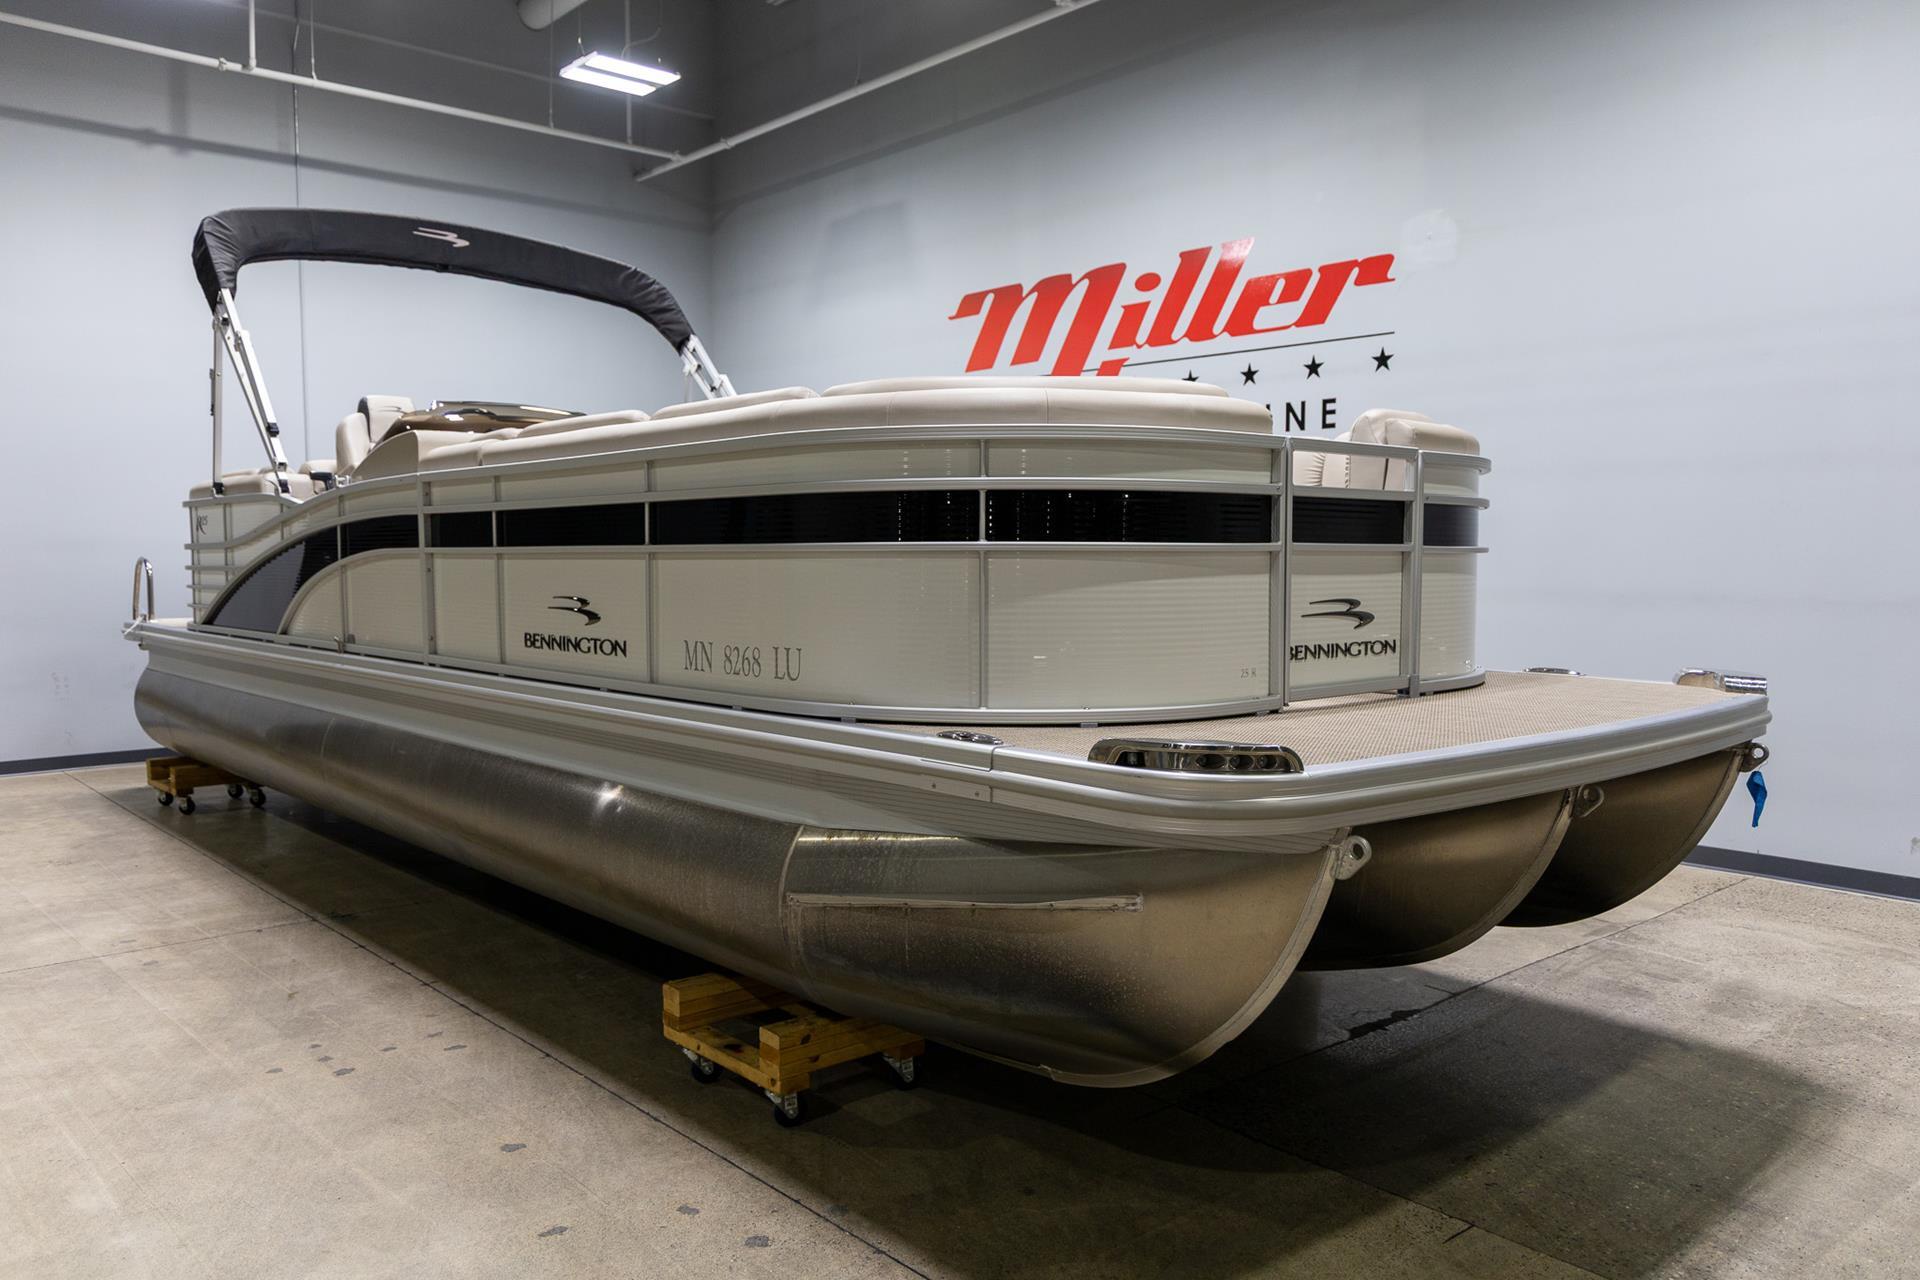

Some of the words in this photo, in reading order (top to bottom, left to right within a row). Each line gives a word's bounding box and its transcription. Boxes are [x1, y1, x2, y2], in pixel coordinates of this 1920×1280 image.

[948, 237, 1396, 376] Miller
[1266, 397, 1337, 432] NE
[524, 632, 627, 658] BENNINGTON
[684, 640, 713, 673] MN
[723, 644, 762, 678] 8268
[772, 646, 802, 681] LU
